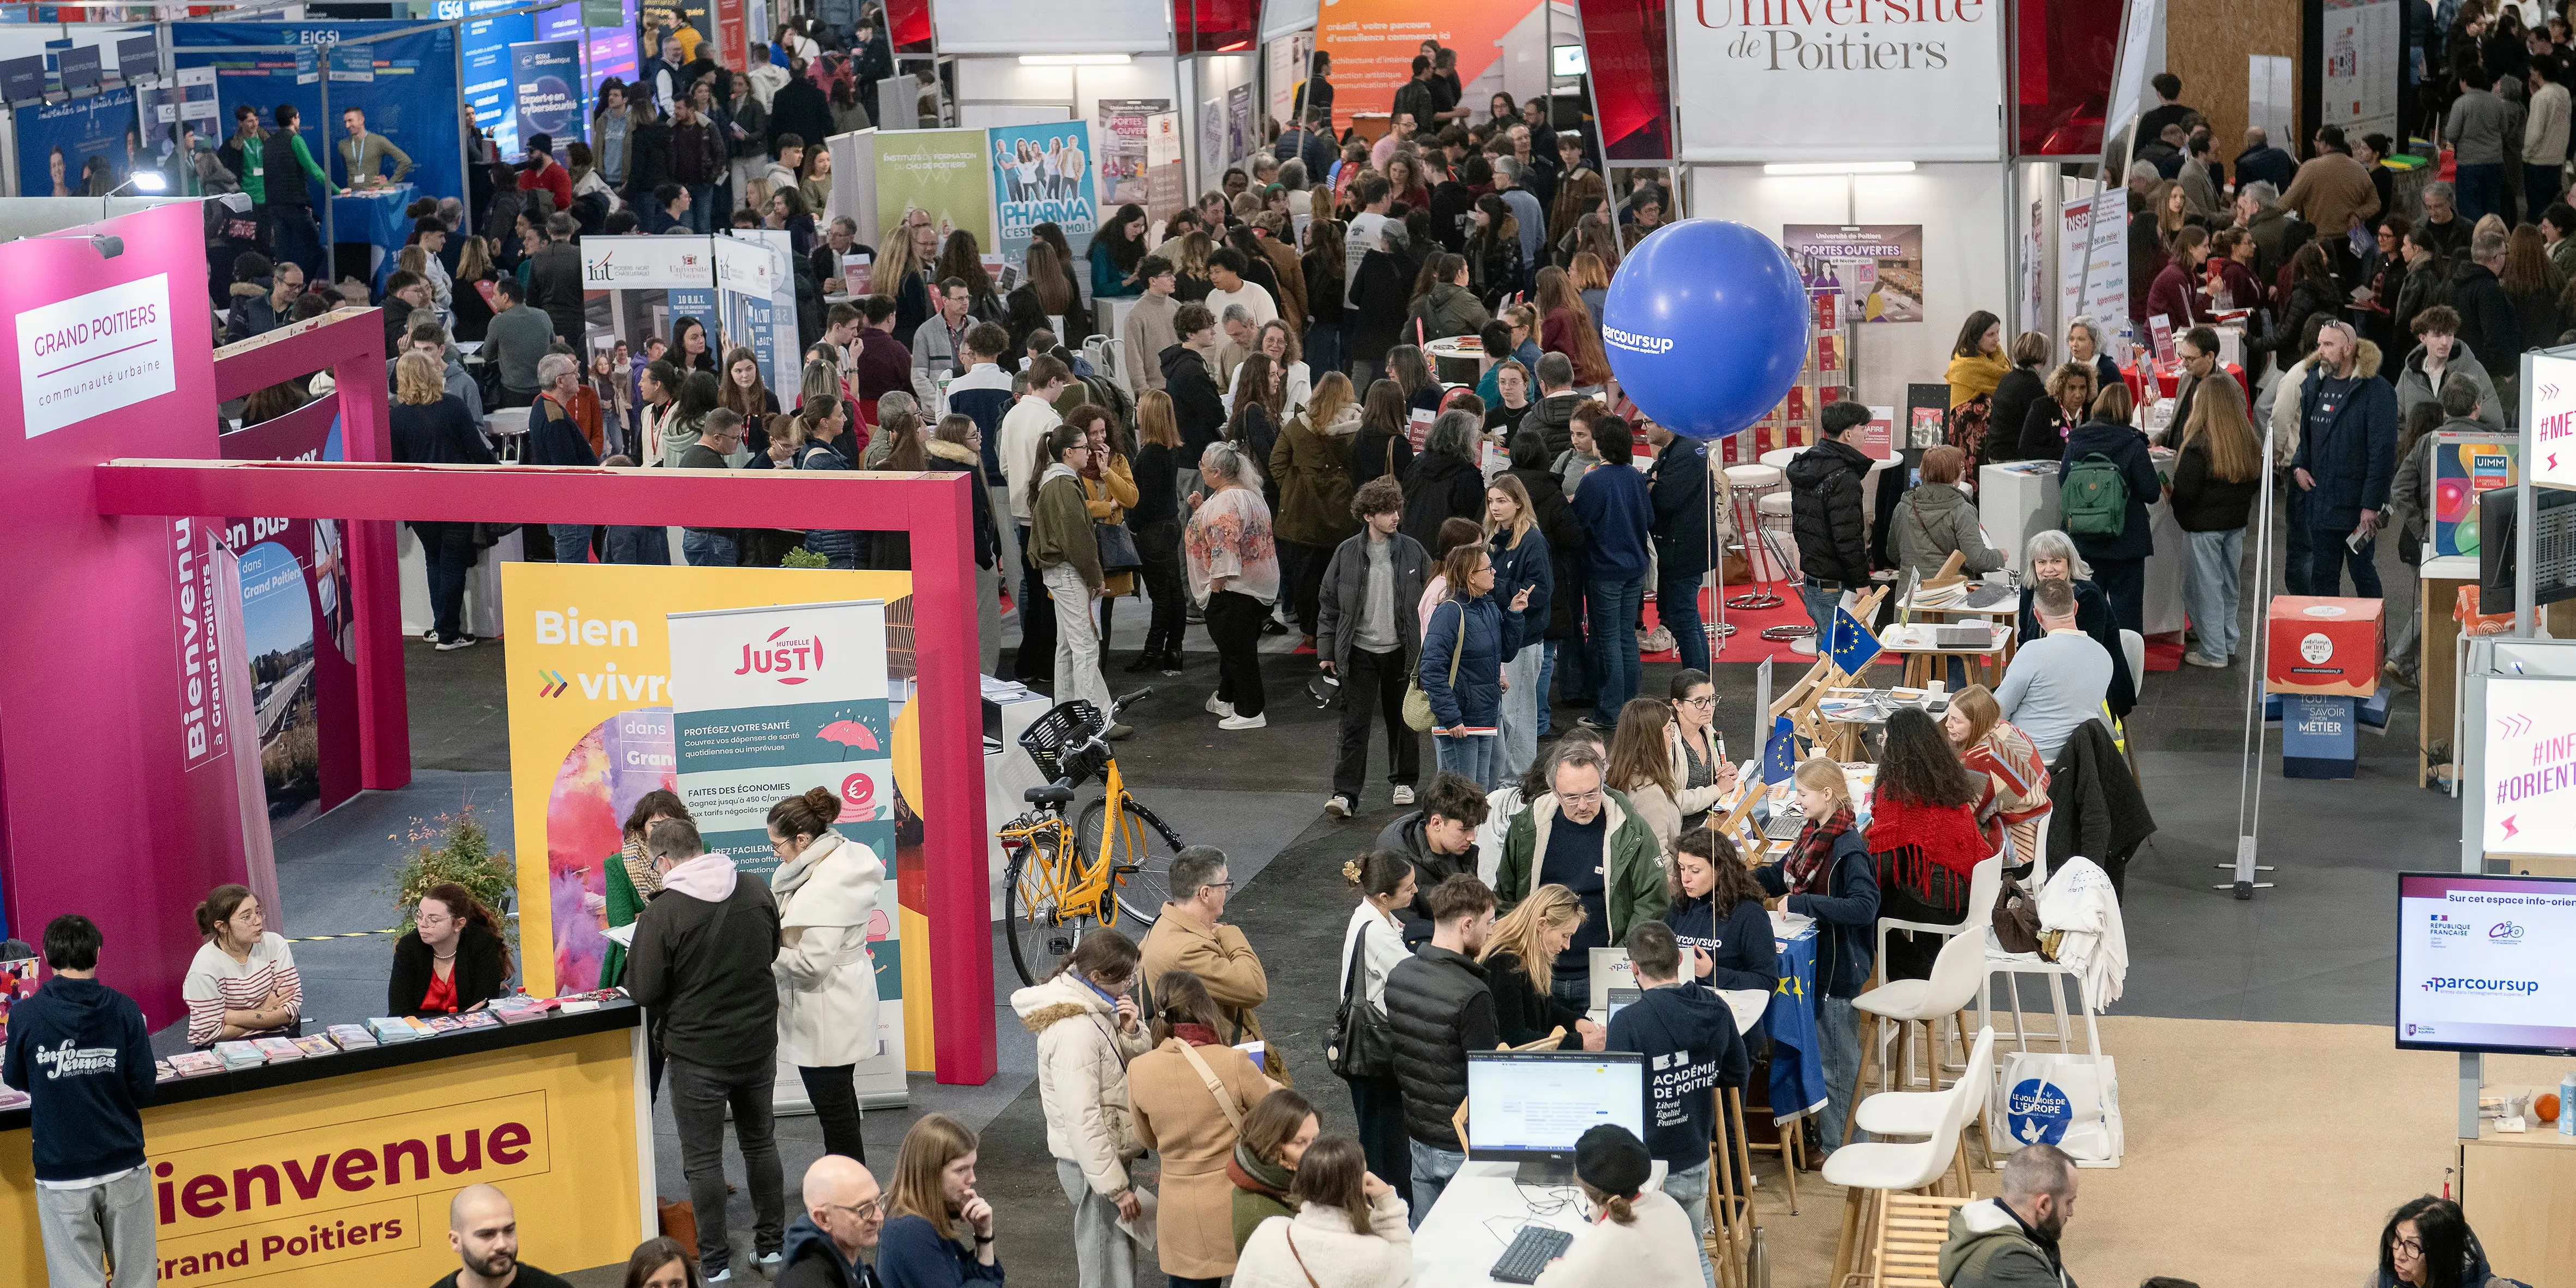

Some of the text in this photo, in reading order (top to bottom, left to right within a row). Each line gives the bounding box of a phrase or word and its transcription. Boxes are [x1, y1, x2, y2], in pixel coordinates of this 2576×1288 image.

[1390, 22, 1431, 31] parcours
[300, 29, 340, 45] EIGSI
[1326, 33, 1386, 43] d'excellence
[1439, 31, 1451, 40] ici
[1728, 29, 1948, 70] de Poitiers
[883, 152, 977, 162] INSTITUTS FORMATION
[906, 161, 921, 170] CHU
[933, 161, 966, 169] POITIERS
[1003, 201, 1090, 226] PHARMA
[1005, 225, 1031, 237] C'EST
[1066, 222, 1086, 233] MOI
[1803, 245, 1900, 256] PORTES OUVERTES
[588, 257, 615, 281] iut
[670, 264, 708, 274] Université
[2106, 276, 2123, 289] Empathie
[678, 295, 705, 304] 10 B.U.T.
[34, 304, 155, 357] GRAND POITIERS
[39, 360, 159, 406] communauté urbaine
[2477, 458, 2505, 467] UIMM
[225, 517, 289, 550] en bus
[243, 558, 262, 574] dans
[243, 567, 300, 599] Grand Poitiers
[535, 606, 638, 647] Bien
[777, 639, 810, 648] MUTUELLE
[202, 562, 222, 746] à Grand Poitiers
[576, 661, 673, 702] vivr
[2301, 694, 2327, 703] TOUT
[2310, 707, 2345, 717] SAVOIR
[625, 720, 666, 735] dans
[684, 719, 791, 737] PROTÉGEZ VOTRE SANTÉ
[2299, 719, 2342, 732] MÉTIER
[685, 738, 715, 747] Couvrez
[730, 734, 767, 746] dépenses
[779, 731, 800, 740] santé
[627, 750, 676, 766] Gran
[685, 748, 733, 759] quotidiennes
[745, 743, 785, 754] imprévues
[688, 783, 790, 797] FAITES DES ÉCONOMIES
[689, 799, 717, 809] Gagnez
[718, 797, 744, 806] jusqu'à
[761, 794, 780, 803] €/an
[705, 809, 723, 817] tarifs
[725, 805, 758, 816] négociés
[2449, 894, 2466, 903] Sur
[2487, 897, 2524, 906] espace
[2435, 977, 2538, 996] parcoursup
[63, 1069, 83, 1078] EXPLORER
[1654, 1069, 1719, 1099] DE POITIES
[1656, 1099, 1681, 1110] Liberté
[1656, 1108, 1681, 1120] Égalité
[1657, 1113, 1689, 1127] Fraternité
[155, 1122, 532, 1225] ienvenue
[262, 1219, 402, 1262] Poitiers
